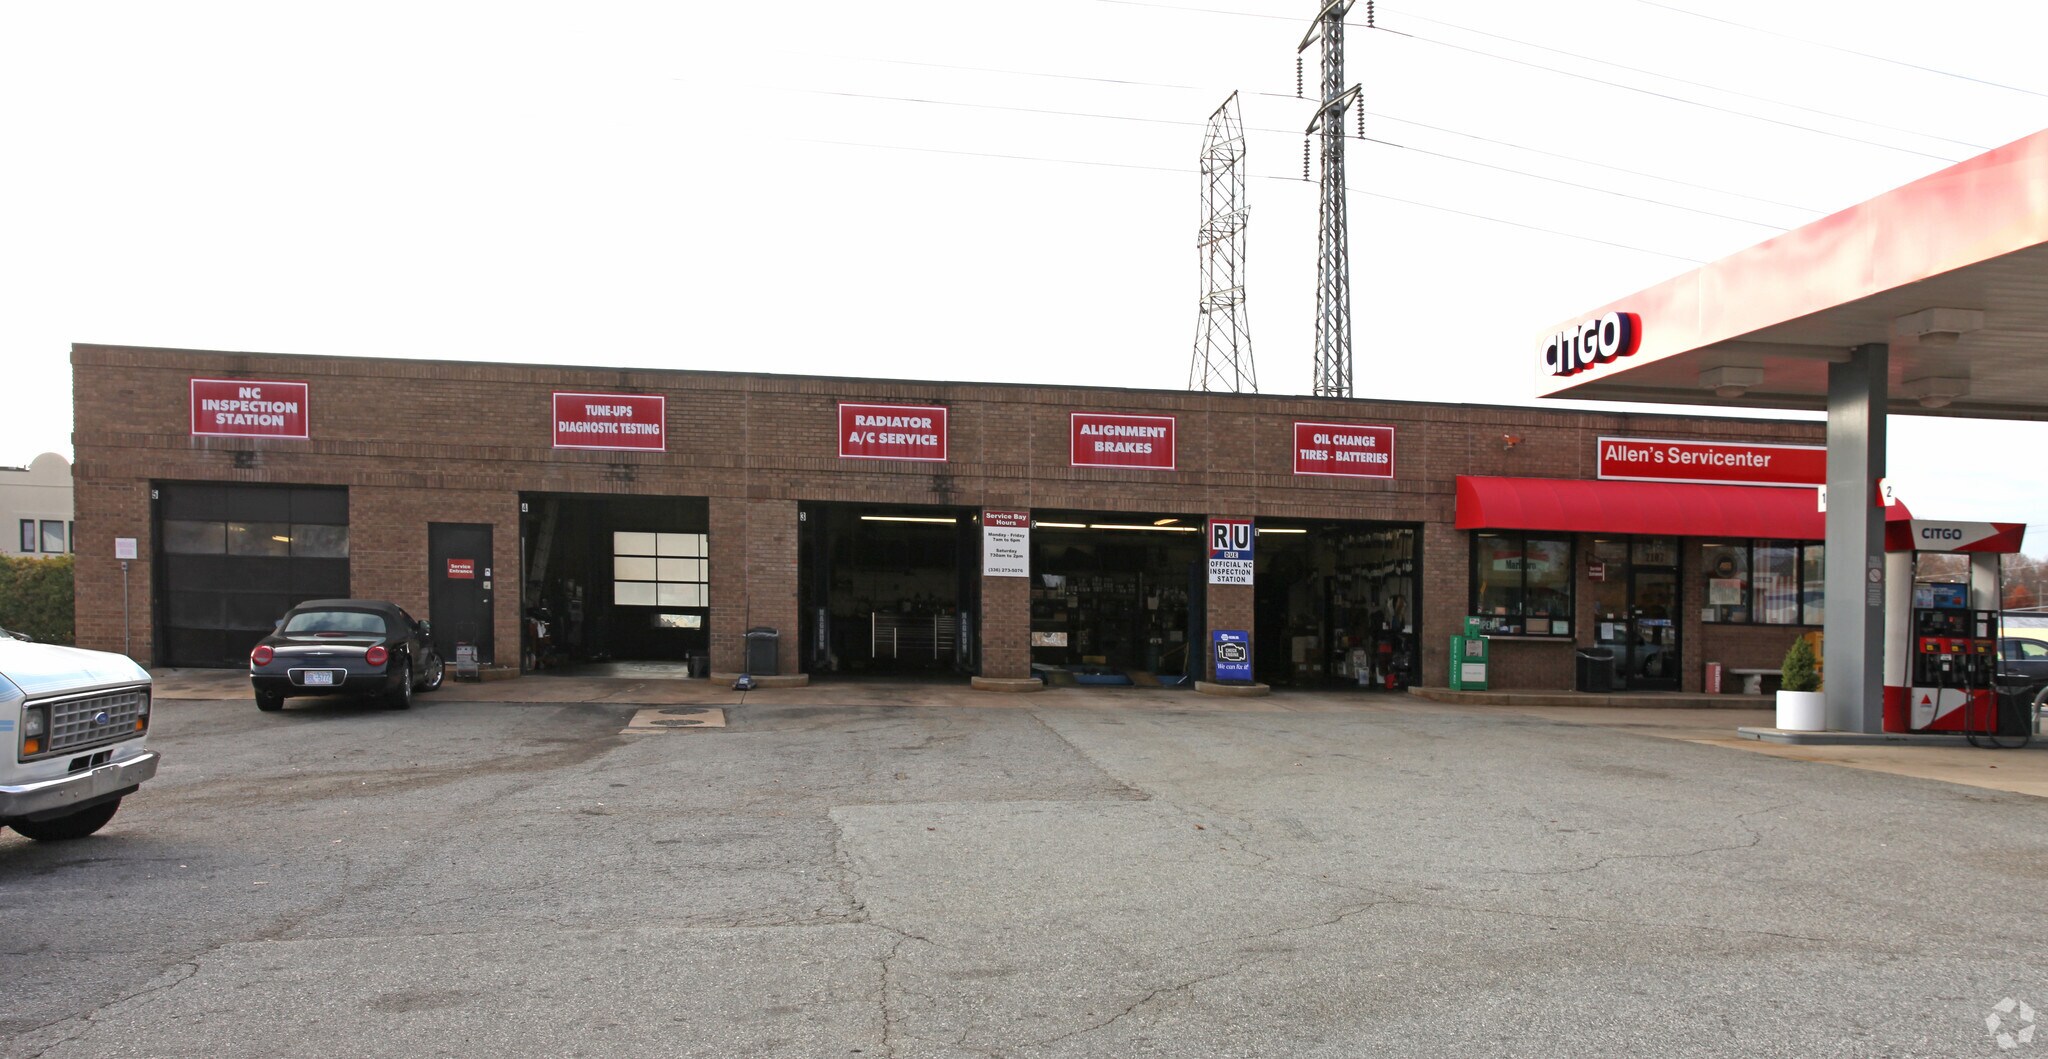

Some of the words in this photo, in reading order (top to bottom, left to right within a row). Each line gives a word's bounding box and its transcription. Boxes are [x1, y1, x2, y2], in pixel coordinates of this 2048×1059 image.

[1541, 312, 1628, 376] CITGO
[239, 387, 261, 399] NC
[202, 399, 298, 414] INSPECTION
[585, 405, 632, 416] TUNE-UPS
[216, 413, 284, 426] STATION
[855, 415, 932, 429] RADIATOR
[559, 421, 618, 434] DIAGNOSTIC
[620, 423, 660, 434] TESTING
[1080, 424, 1166, 438] ALIGNMENT
[849, 431, 876, 446] A/C
[878, 432, 938, 446] SERVICE
[1313, 433, 1331, 444] OIL
[1333, 434, 1376, 446] CHANGE
[1094, 441, 1153, 454] BRAKES
[1300, 449, 1328, 460] TIRES
[1336, 450, 1388, 464] BATTERIES
[1605, 444, 1664, 464] Allen's
[1667, 447, 1772, 468] Servicenter
[1886, 486, 1892, 498] 2
[1922, 528, 1962, 540] CITGO
